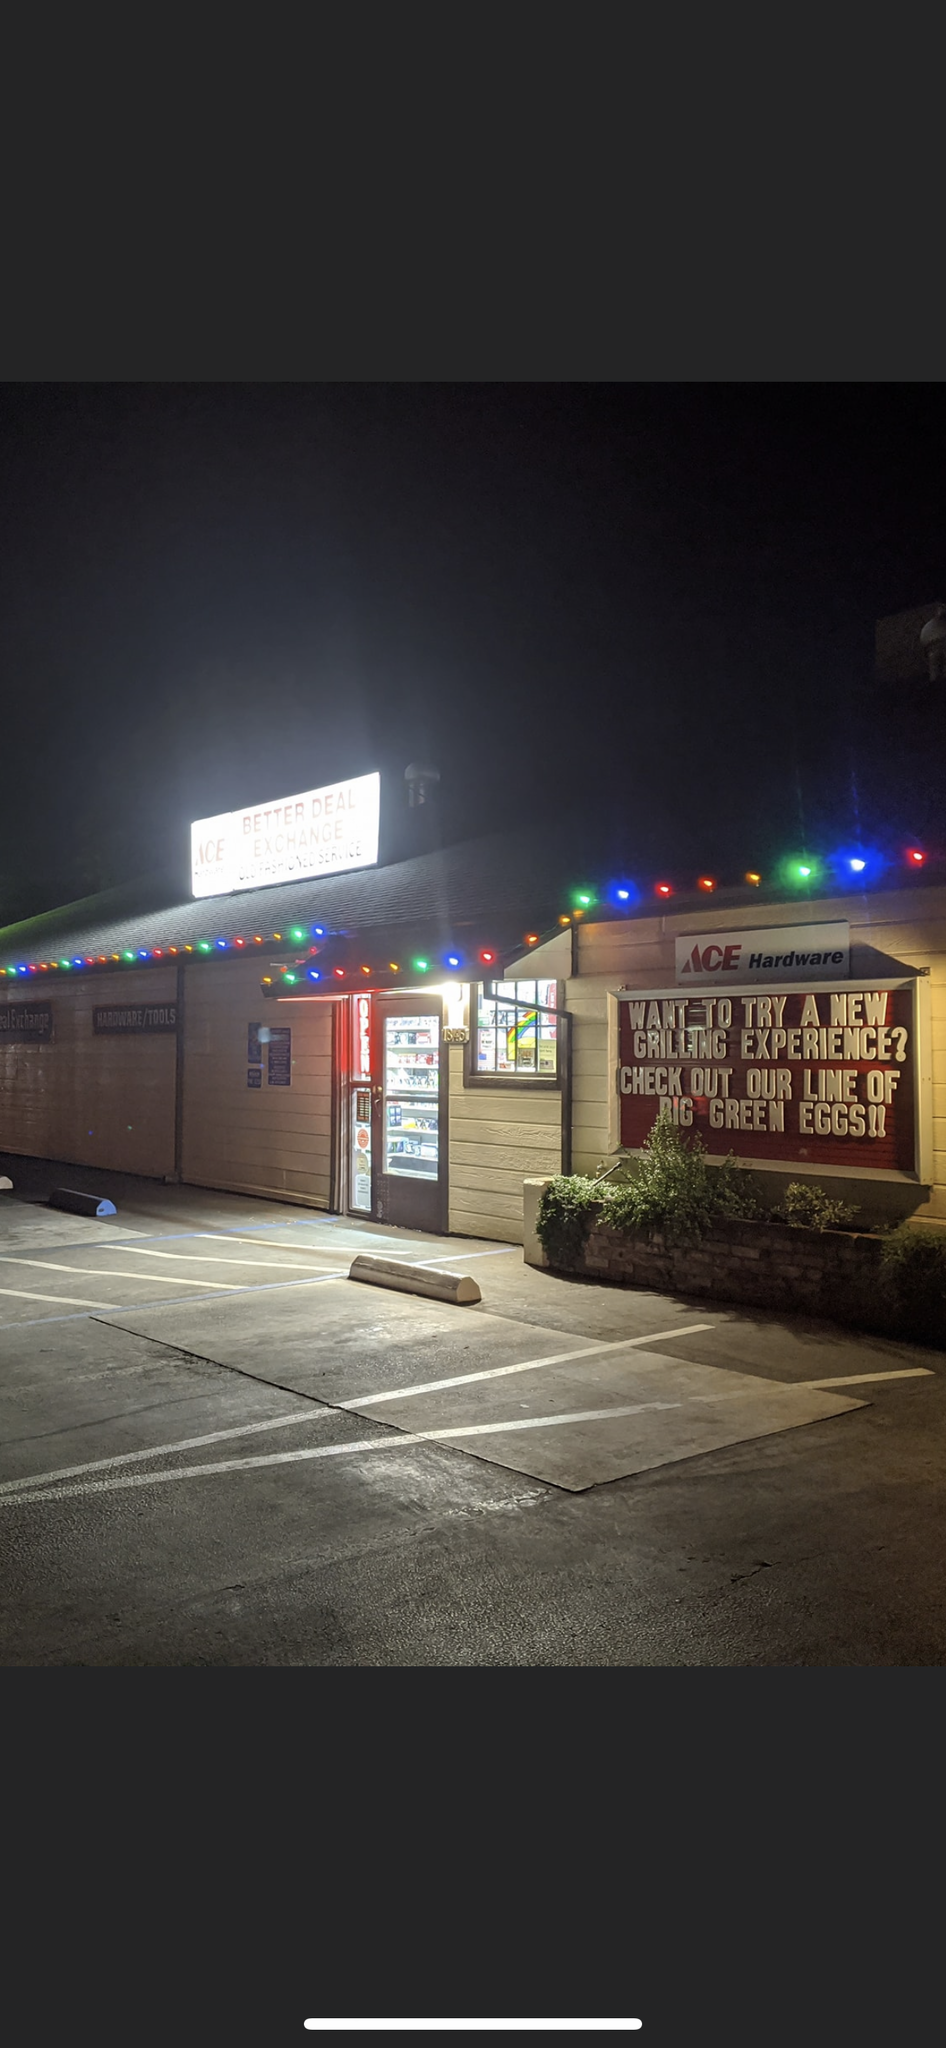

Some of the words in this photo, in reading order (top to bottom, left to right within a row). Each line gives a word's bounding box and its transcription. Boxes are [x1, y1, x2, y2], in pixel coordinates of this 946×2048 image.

[243, 802, 305, 835] BETTER
[312, 789, 356, 818] DEAL
[195, 838, 225, 866] ACE
[254, 819, 343, 858] EXCHANGE
[319, 840, 362, 864] SERVICE
[681, 944, 742, 973] ACE
[748, 951, 844, 969] Hardware
[11, 1009, 49, 1034] Exchange
[97, 1008, 176, 1028] HARDWARE/TOOLS
[628, 999, 689, 1030] WANT
[702, 998, 732, 1029] TO
[741, 996, 787, 1028] TRY
[800, 994, 820, 1026] A
[830, 992, 888, 1026] NEW
[633, 1029, 727, 1059] GRILLING
[741, 1026, 908, 1062] EXPERIENCE?
[620, 1066, 683, 1096] CHECK
[691, 1067, 733, 1098] OUT
[746, 1068, 792, 1100] OUR
[803, 1068, 858, 1102] LINE
[867, 1070, 900, 1104] OF
[709, 1098, 785, 1132] GREEN
[799, 1101, 886, 1137] EGGS!!
